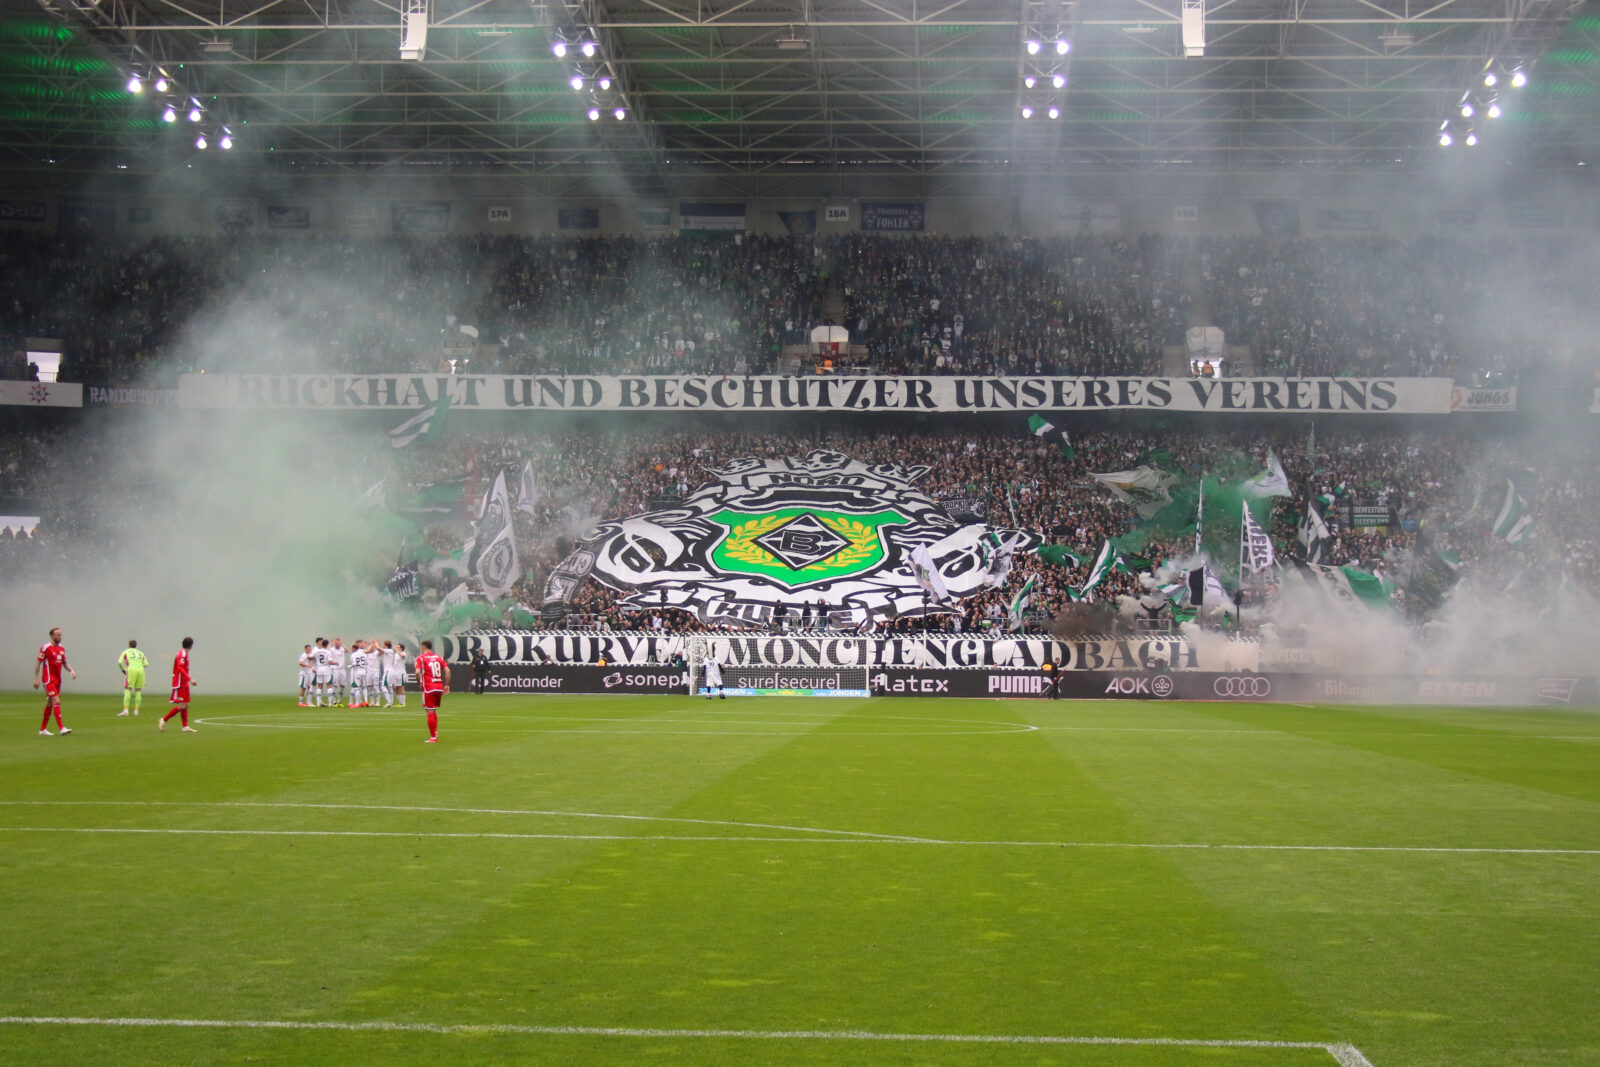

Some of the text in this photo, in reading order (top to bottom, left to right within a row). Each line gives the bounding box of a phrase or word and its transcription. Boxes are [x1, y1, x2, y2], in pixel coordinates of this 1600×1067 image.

[827, 209, 846, 218] 16A
[503, 377, 603, 408] UND
[954, 379, 1173, 408] UNSERES
[1187, 380, 1398, 411] VEREINS
[1466, 390, 1510, 405] JUNGS
[768, 473, 867, 487] NORD
[319, 654, 325, 664] 2
[355, 656, 366, 667] 25
[428, 661, 442, 678] 18
[490, 674, 563, 688] Santander
[870, 674, 949, 692] flatex
[988, 675, 1042, 693] PUMA
[1105, 677, 1150, 694] AOK
[829, 689, 861, 697] JONGEN
[1418, 681, 1497, 697] ELTEN
